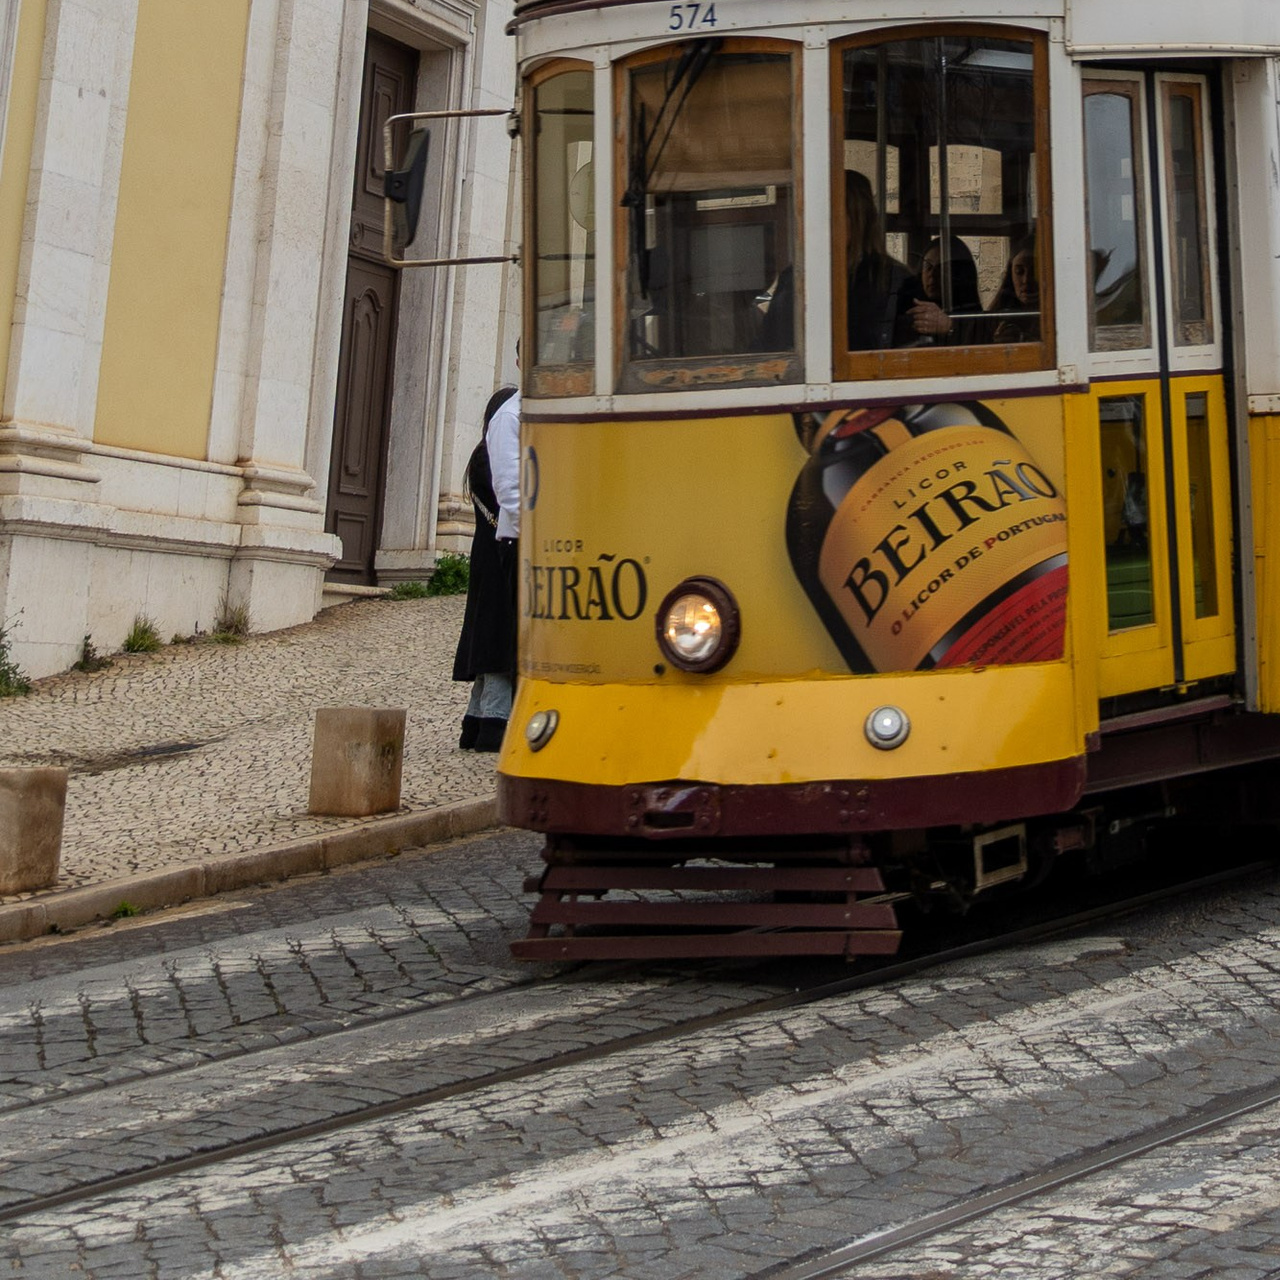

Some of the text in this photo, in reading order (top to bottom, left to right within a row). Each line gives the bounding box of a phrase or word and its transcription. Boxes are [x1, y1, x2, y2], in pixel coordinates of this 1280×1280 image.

[669, 3, 718, 31] 574
[892, 461, 967, 509] LICOR
[544, 539, 584, 553] LICOR
[842, 459, 1058, 629] BEIRÃO
[891, 620, 903, 636] O
[902, 568, 955, 621] LICOR
[954, 546, 984, 572] DE
